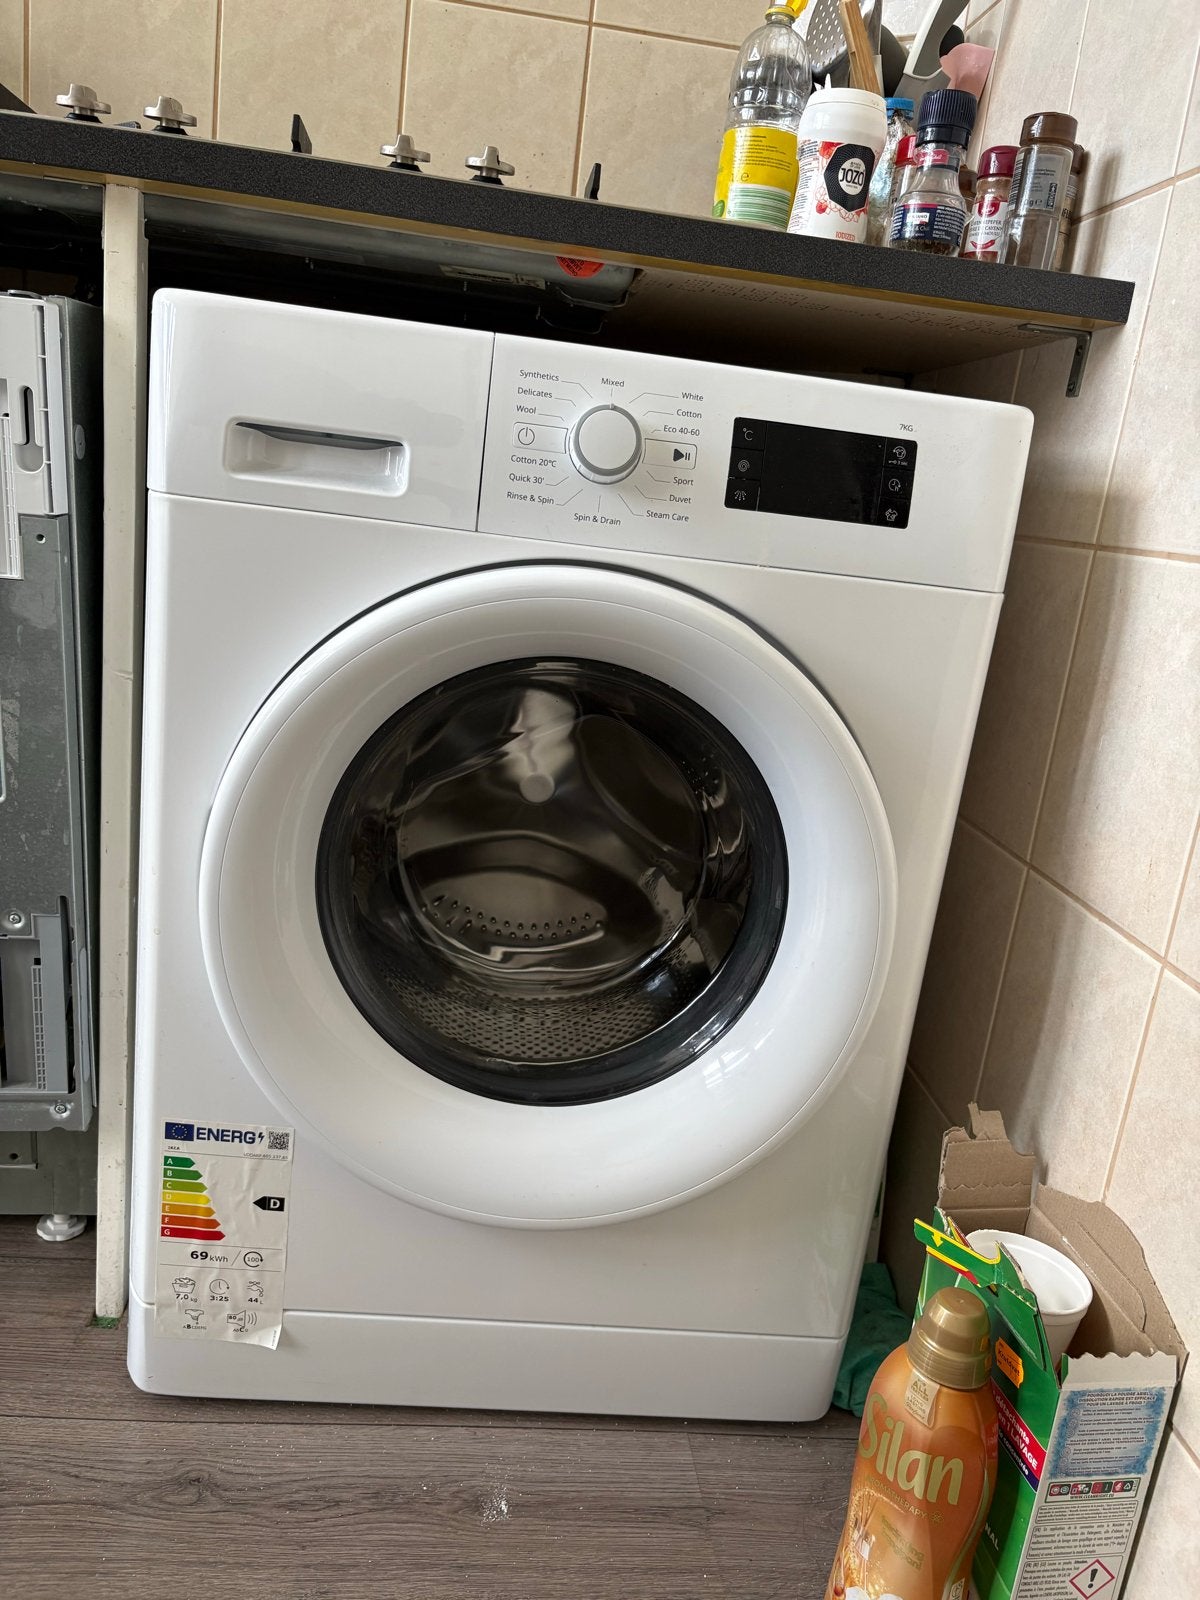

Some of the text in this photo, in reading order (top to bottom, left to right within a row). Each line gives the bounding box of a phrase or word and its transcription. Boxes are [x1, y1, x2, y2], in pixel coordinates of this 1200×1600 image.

[839, 168, 865, 187] JOZO
[519, 369, 559, 381] Synthetics
[601, 377, 625, 387] Mixed
[517, 387, 553, 399] Delicates
[681, 391, 704, 402] White
[516, 404, 537, 415] Wool
[676, 408, 702, 419] Cotton
[663, 424, 700, 436] Eco 40-60
[899, 423, 914, 432] 7KG
[510, 454, 557, 468] Cotton 20°C
[508, 472, 545, 484] Quick 30'
[673, 476, 694, 486] Sport
[506, 491, 555, 505] Rinse & Spin
[669, 494, 692, 504] Duvet
[573, 512, 591, 523] Spin
[600, 516, 621, 526] Drain
[646, 509, 690, 522] Steam Care
[196, 1126, 256, 1145] ENERG
[270, 1199, 280, 1209] D
[190, 1250, 228, 1263] 69 kWh
[175, 1293, 189, 1301] 7,0
[858, 1392, 964, 1505] Silan
[1010, 1427, 1038, 1470] LAVAGE
[866, 1476, 928, 1519] ROMATHERAPY
